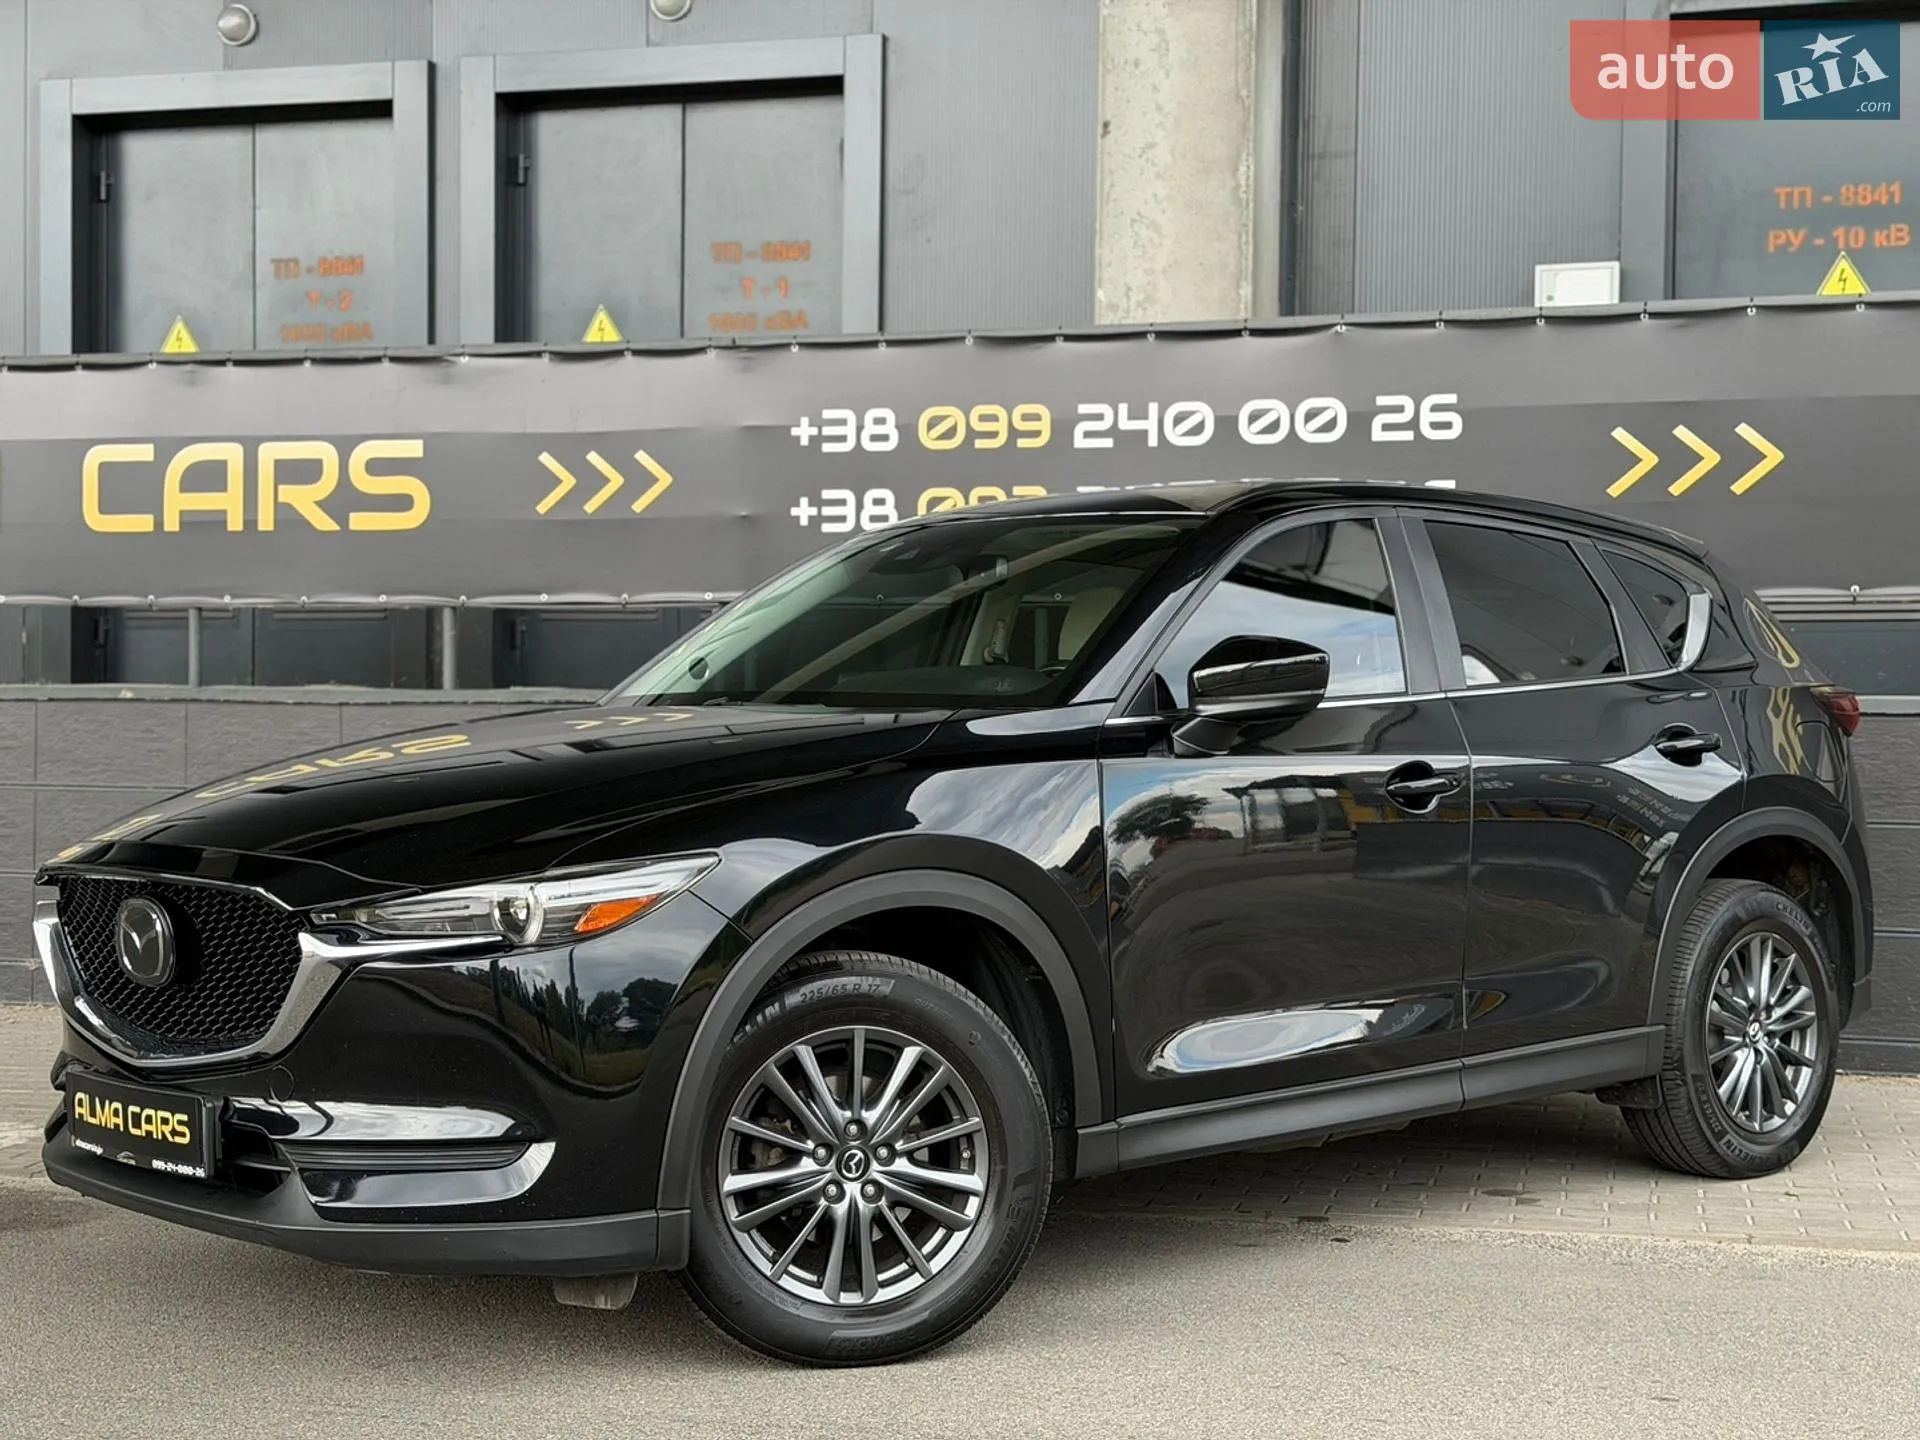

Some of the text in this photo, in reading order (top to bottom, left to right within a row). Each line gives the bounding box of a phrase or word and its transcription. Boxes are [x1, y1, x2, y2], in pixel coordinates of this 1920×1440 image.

[1774, 185, 1813, 211] ТП
[1840, 180, 1903, 207] 8841
[1767, 228, 1808, 254] РУ
[1832, 226, 1867, 249] 10
[1873, 223, 1911, 248] кВ
[339, 290, 353, 313] 2
[790, 393, 1463, 453] +38 099 240 00 26
[82, 439, 431, 533] CARS
[790, 488, 898, 534] +38
[800, 983, 849, 1004] 225/65
[851, 983, 862, 994] R
[74, 1091, 191, 1145] ALMA CARS
